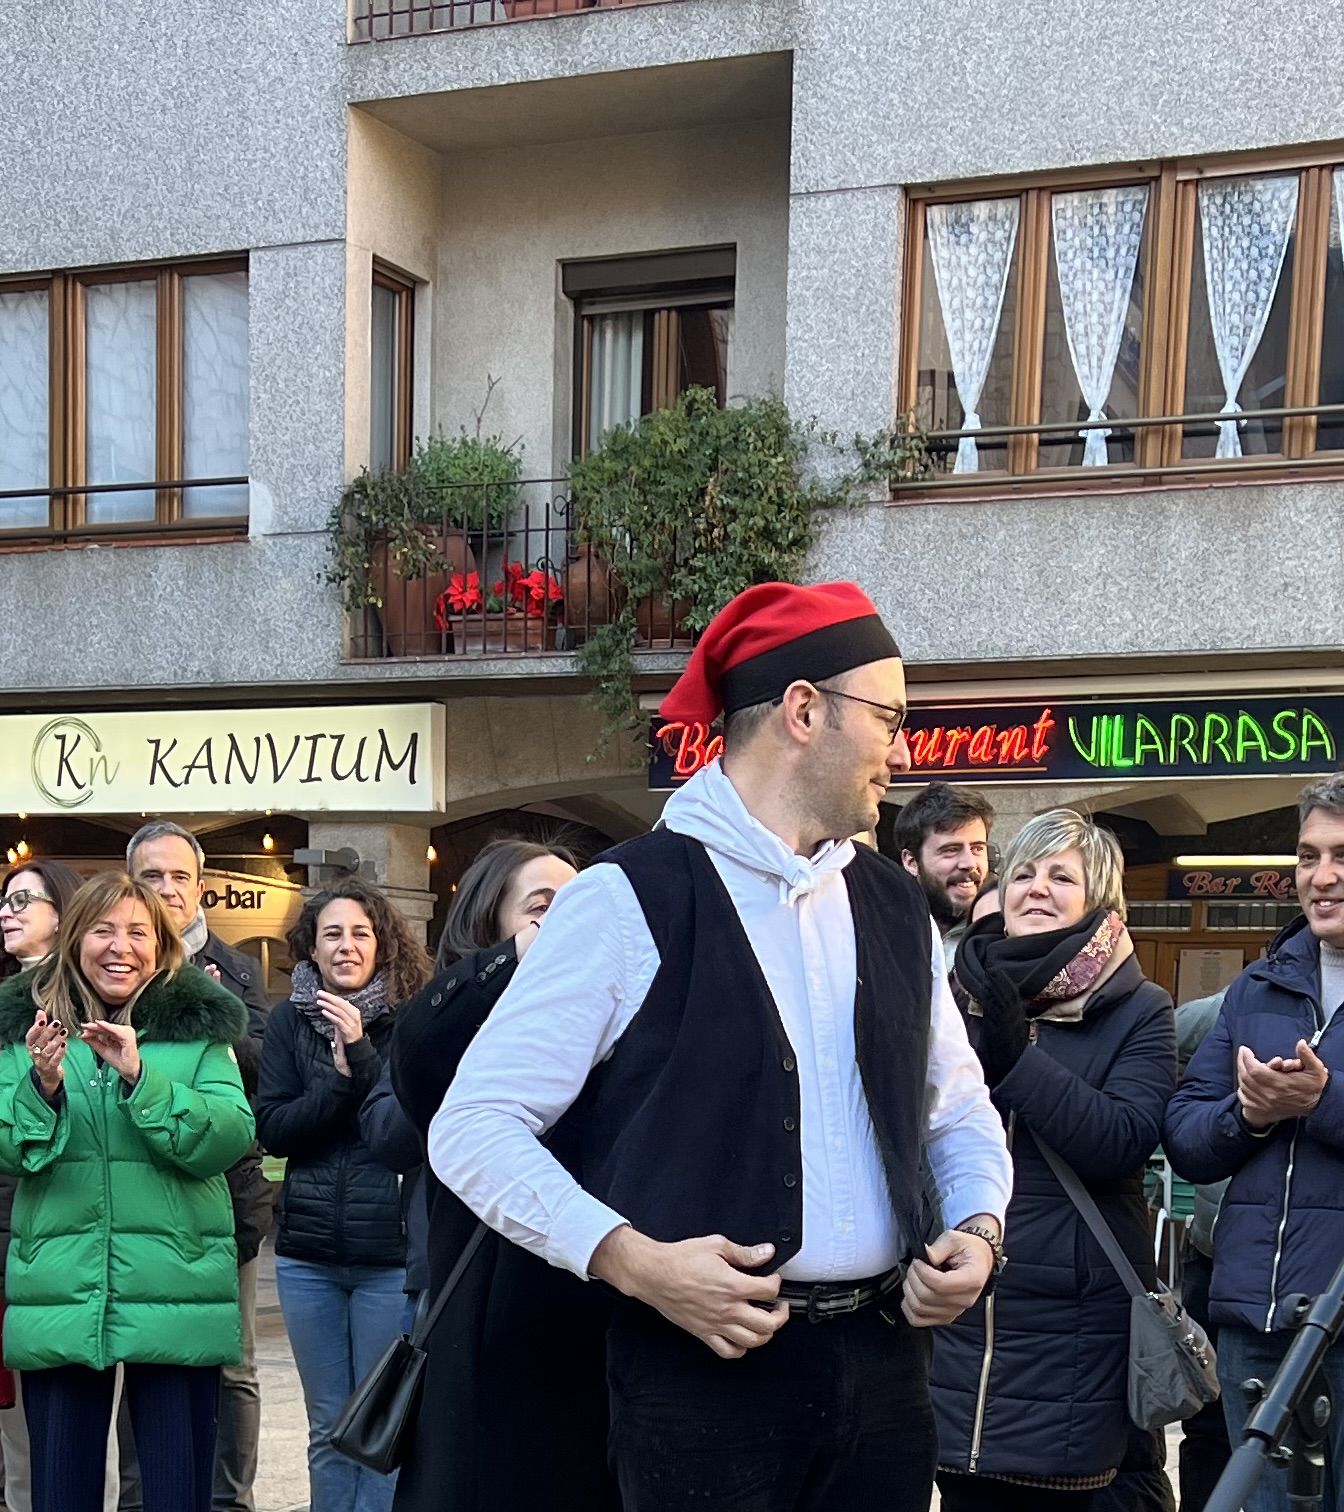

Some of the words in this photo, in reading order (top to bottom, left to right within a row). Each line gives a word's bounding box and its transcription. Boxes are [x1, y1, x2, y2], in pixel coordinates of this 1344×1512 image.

[147, 728, 419, 788] KANVIUM
[1067, 708, 1337, 767] VILARRASA
[1182, 870, 1241, 894] Bar
